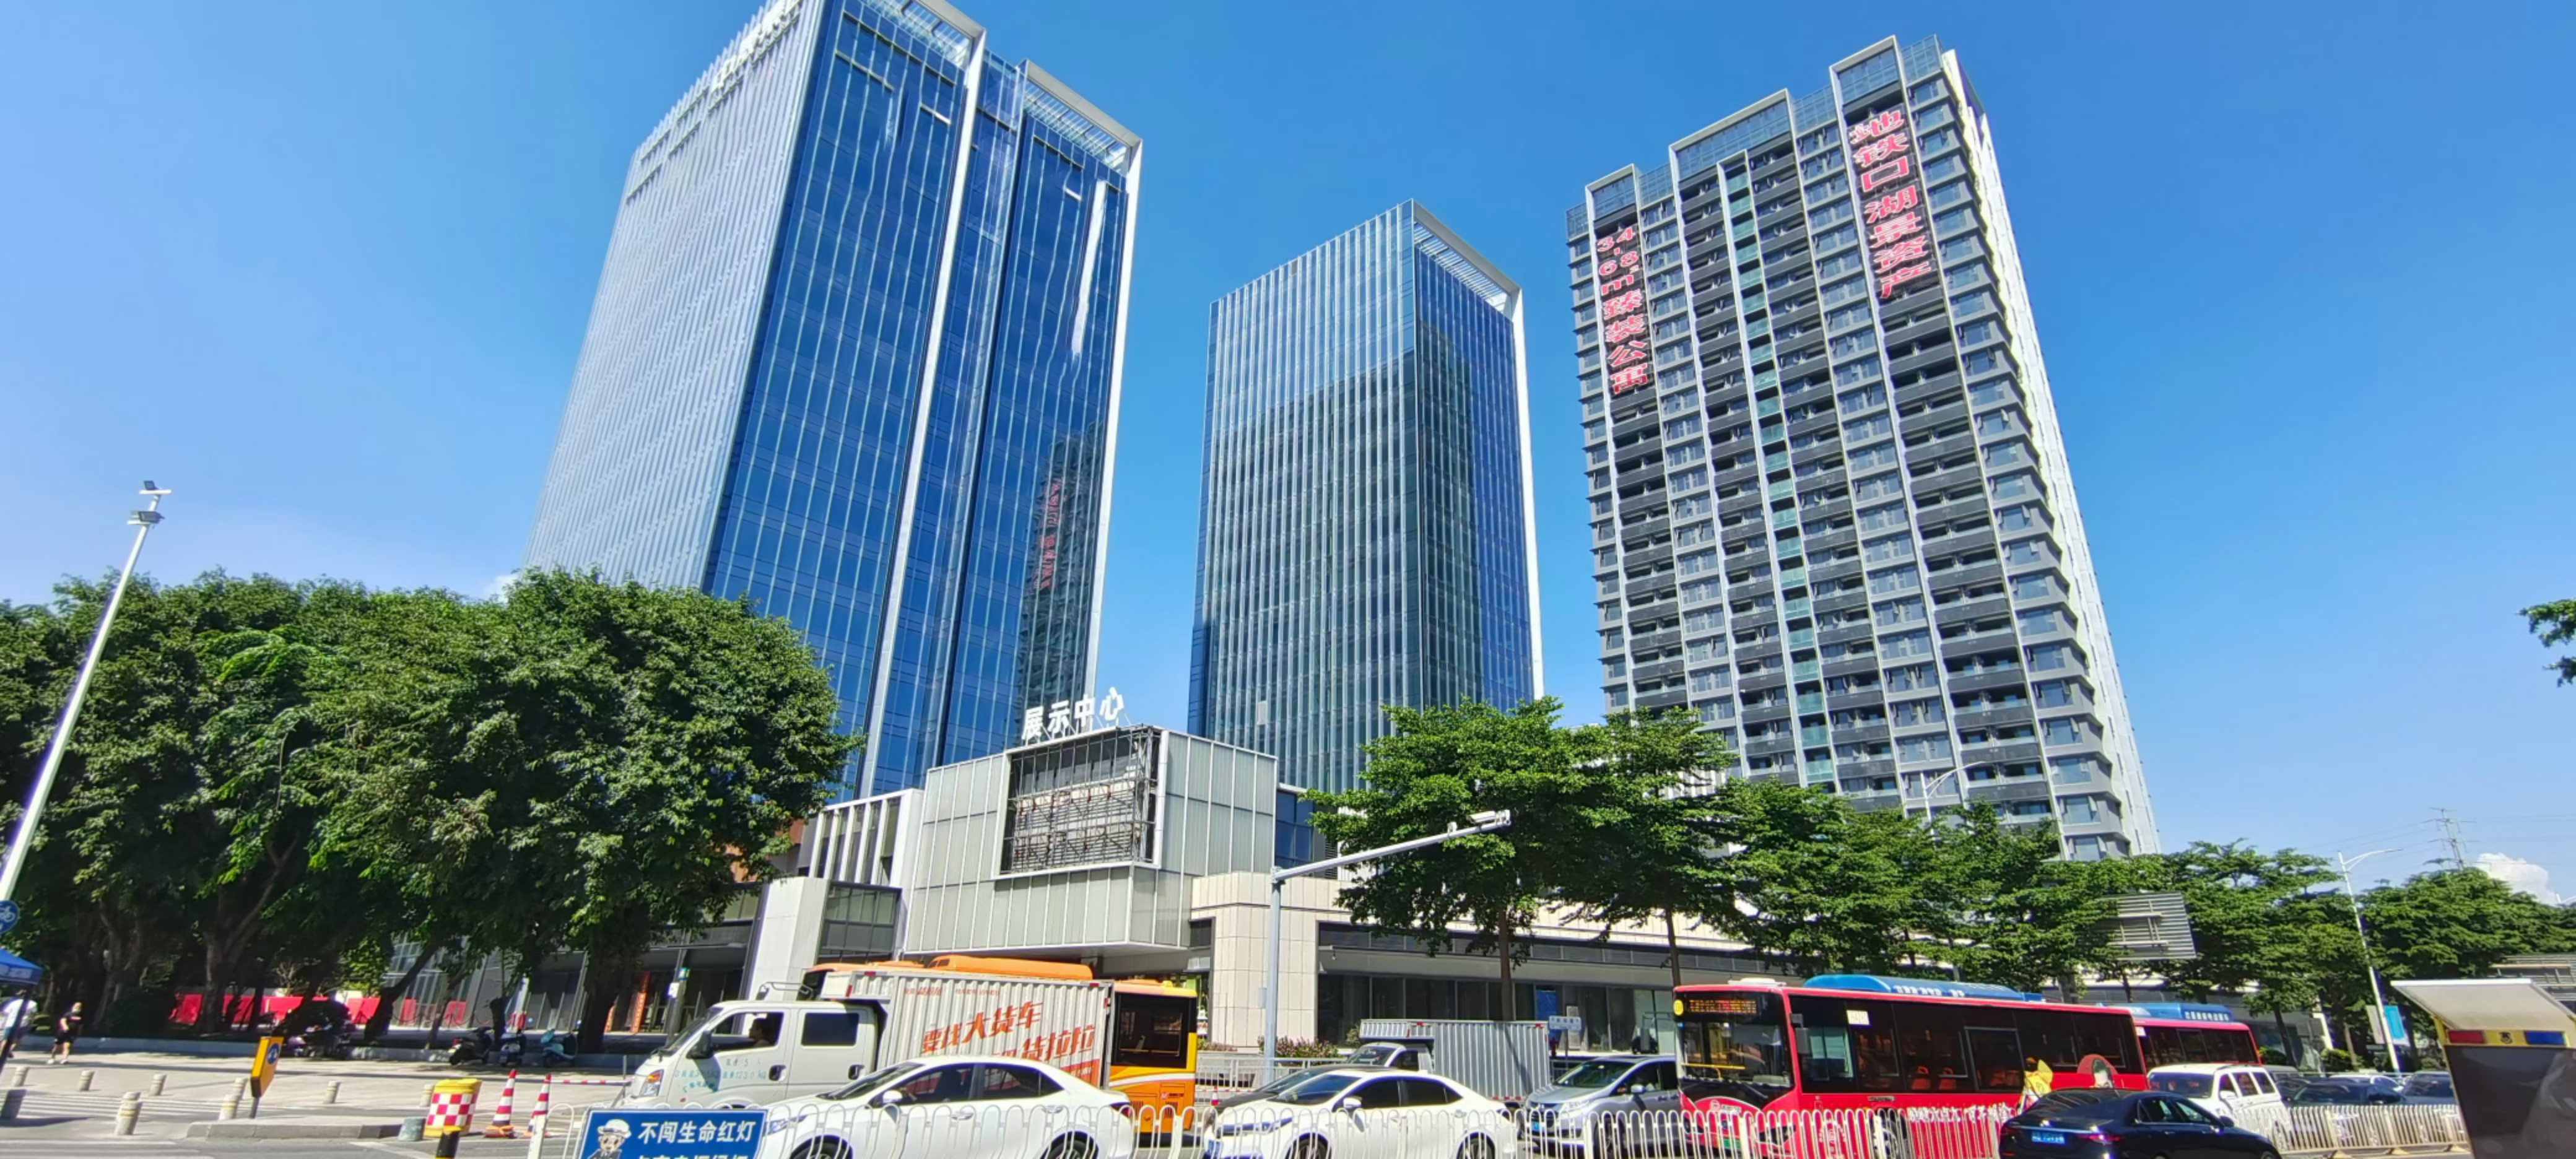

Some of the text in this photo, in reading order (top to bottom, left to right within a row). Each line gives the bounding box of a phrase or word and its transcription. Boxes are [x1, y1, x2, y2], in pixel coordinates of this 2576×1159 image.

[1848, 110, 1931, 298] 地铁口湖景资产
[1022, 687, 1125, 740] 展示中心
[921, 1001, 1044, 1054] 要找大货车
[638, 1119, 756, 1145] 不闯生命红灯
